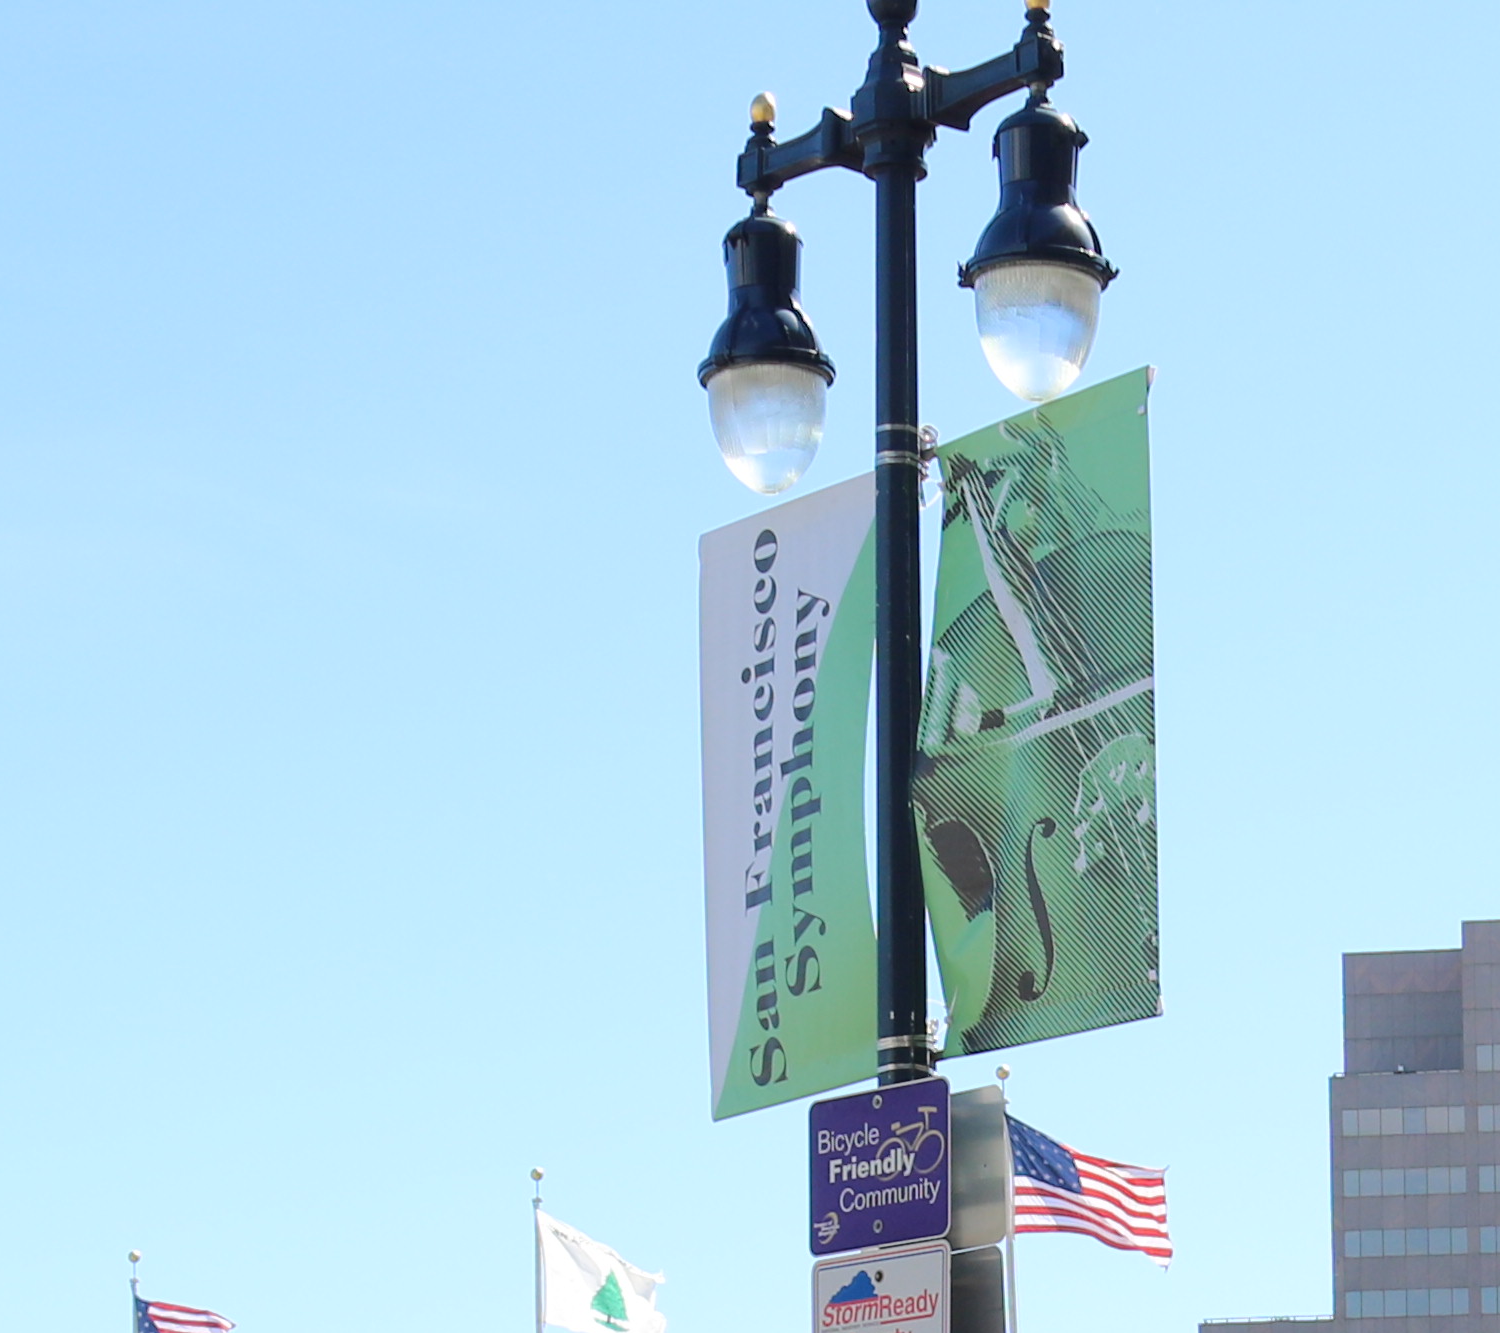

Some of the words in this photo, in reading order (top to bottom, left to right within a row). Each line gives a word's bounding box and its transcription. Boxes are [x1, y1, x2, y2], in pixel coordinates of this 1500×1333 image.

[741, 528, 780, 918] Francisco
[780, 587, 830, 997] Symphony
[749, 934, 789, 1088] San
[818, 1122, 880, 1156] Bicycle
[829, 1148, 915, 1183] Friendly
[840, 1178, 940, 1212] Community
[822, 1288, 939, 1327] StormReady
